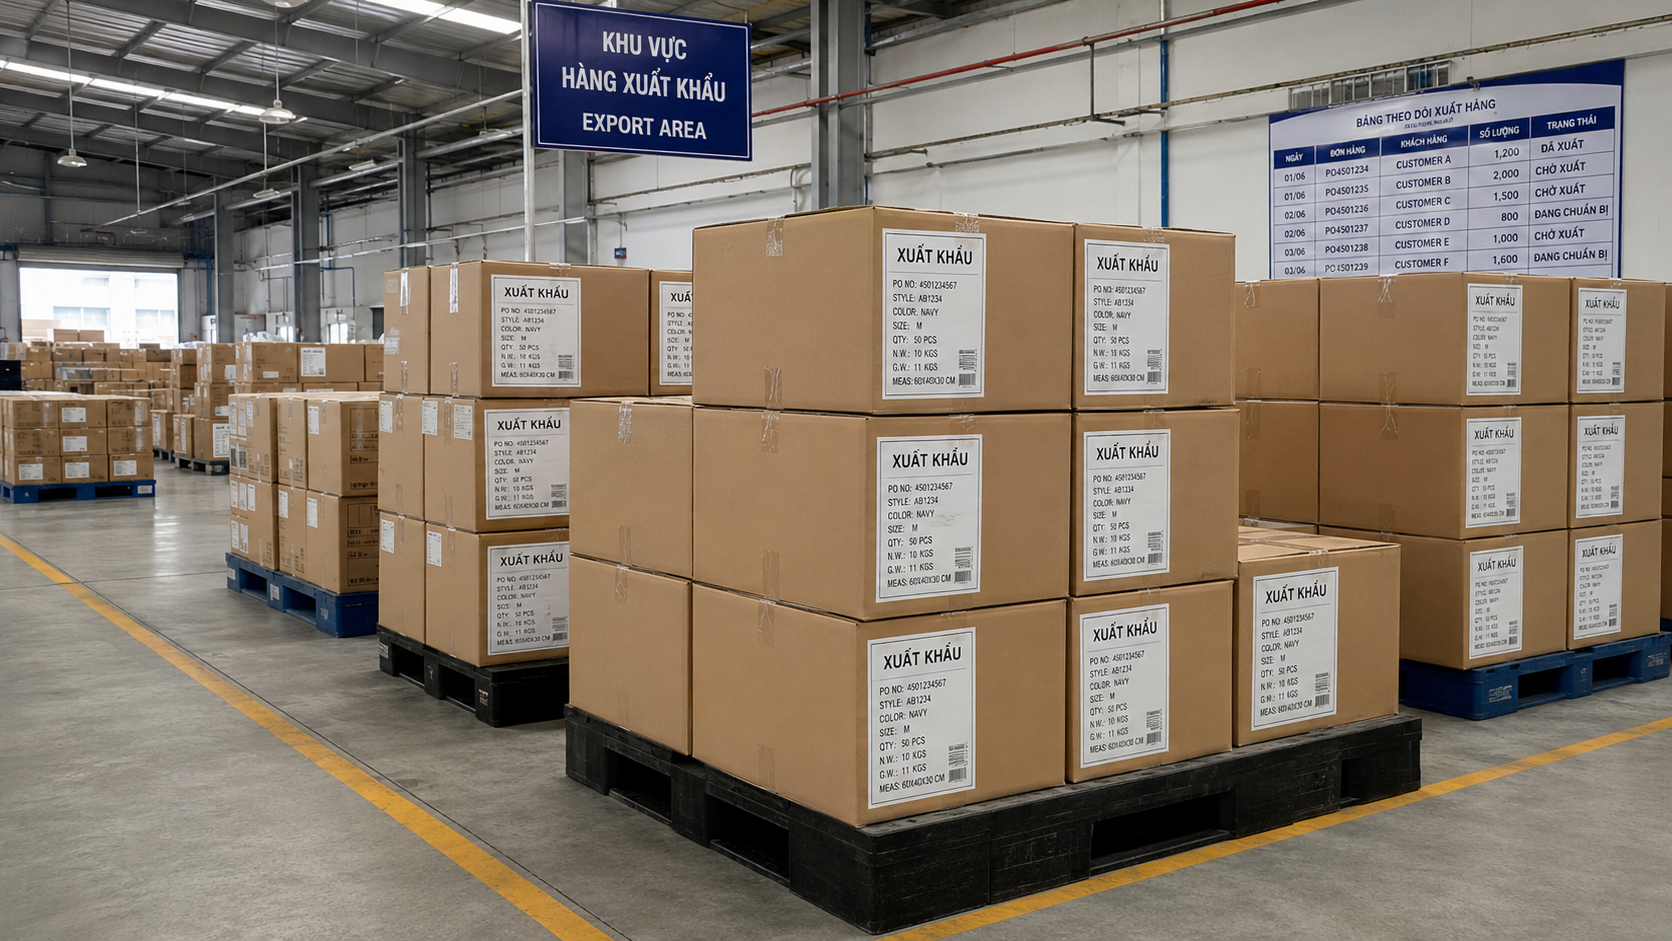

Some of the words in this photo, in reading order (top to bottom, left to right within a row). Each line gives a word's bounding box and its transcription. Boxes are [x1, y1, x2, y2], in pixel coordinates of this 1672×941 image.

[603, 31, 642, 55] KHU
[648, 36, 687, 63] VỰC
[562, 62, 617, 93] HÀNG
[677, 72, 726, 102] KHẨU
[1385, 111, 1411, 123] THEO
[583, 112, 654, 136] EXPORT
[659, 119, 707, 140] AREA
[1284, 171, 1306, 183] 01/06
[1396, 157, 1442, 170] CUSTOMER
[1444, 155, 1451, 165] A
[1494, 146, 1520, 160] 1,200
[1284, 190, 1306, 201] 01/06
[1396, 178, 1442, 189] CUSTOMER
[1444, 176, 1451, 185] B
[1493, 168, 1519, 181] 2,000
[1284, 209, 1306, 221] 02/06
[1396, 198, 1442, 210] CUSTOMER
[1444, 196, 1451, 206] C
[1493, 190, 1519, 203] 1,500
[1535, 184, 1557, 198] CHỜ
[1284, 228, 1306, 239] 02/06
[1395, 218, 1441, 230] CUSTOMER
[1444, 216, 1450, 226] D
[1501, 212, 1519, 222] 800
[1534, 208, 1561, 219] ĐANG
[1599, 204, 1609, 216] BỊ
[1395, 239, 1441, 250] CUSTOMER
[1444, 237, 1449, 247] E
[1493, 233, 1518, 245] 1,000
[1534, 228, 1556, 241] CHỜ
[897, 244, 932, 264] XUẤT
[1395, 259, 1440, 270] CUSTOMER
[1444, 258, 1449, 267] F
[1493, 254, 1518, 267] 1,600
[1534, 251, 1560, 262] ĐANG
[1598, 249, 1608, 261] BỊ
[893, 280, 903, 288] PO
[905, 280, 917, 289] NO:
[919, 281, 957, 289] 4501234567
[893, 294, 916, 302] STYLE:
[921, 308, 939, 316] NAVY
[893, 336, 908, 344] QTY:
[914, 336, 922, 344] 50
[924, 336, 937, 344] PCS
[914, 350, 922, 358] 10
[924, 349, 938, 358] KGS
[924, 363, 938, 371] KGS
[893, 377, 913, 386] MEAS:
[945, 376, 956, 384] CM
[892, 449, 928, 468] XUẤT
[888, 484, 898, 493] PO
[900, 484, 912, 492] NO:
[915, 482, 953, 491] 4501234567
[888, 498, 911, 506] STYLE:
[888, 511, 914, 520] COLOR:
[916, 510, 935, 518] NAVY
[888, 524, 905, 533] SIZE:
[912, 524, 918, 532] M
[888, 538, 904, 547] QTY:
[909, 537, 917, 545] 50
[919, 536, 932, 544] PCS
[909, 551, 917, 559] 10
[920, 549, 933, 558] KGS
[909, 564, 916, 572] 11
[920, 563, 934, 571] KGS
[941, 574, 951, 582] CM
[1093, 621, 1124, 642] XUẤT
[884, 648, 920, 670] XUẤT
[880, 687, 889, 696] PO
[891, 685, 904, 694] NO:
[907, 678, 947, 691] 4501234567
[879, 712, 906, 723] COLOR:
[909, 709, 928, 719] NAVY
[880, 727, 897, 737] SIZE:
[904, 725, 910, 733] M
[880, 741, 897, 752] QTY:
[901, 738, 910, 748] 50
[912, 736, 926, 746] PCS
[901, 752, 910, 761] 10
[912, 750, 927, 760] KGS
[902, 766, 909, 775] 11
[913, 763, 927, 773] KGS
[934, 774, 945, 783] CM
